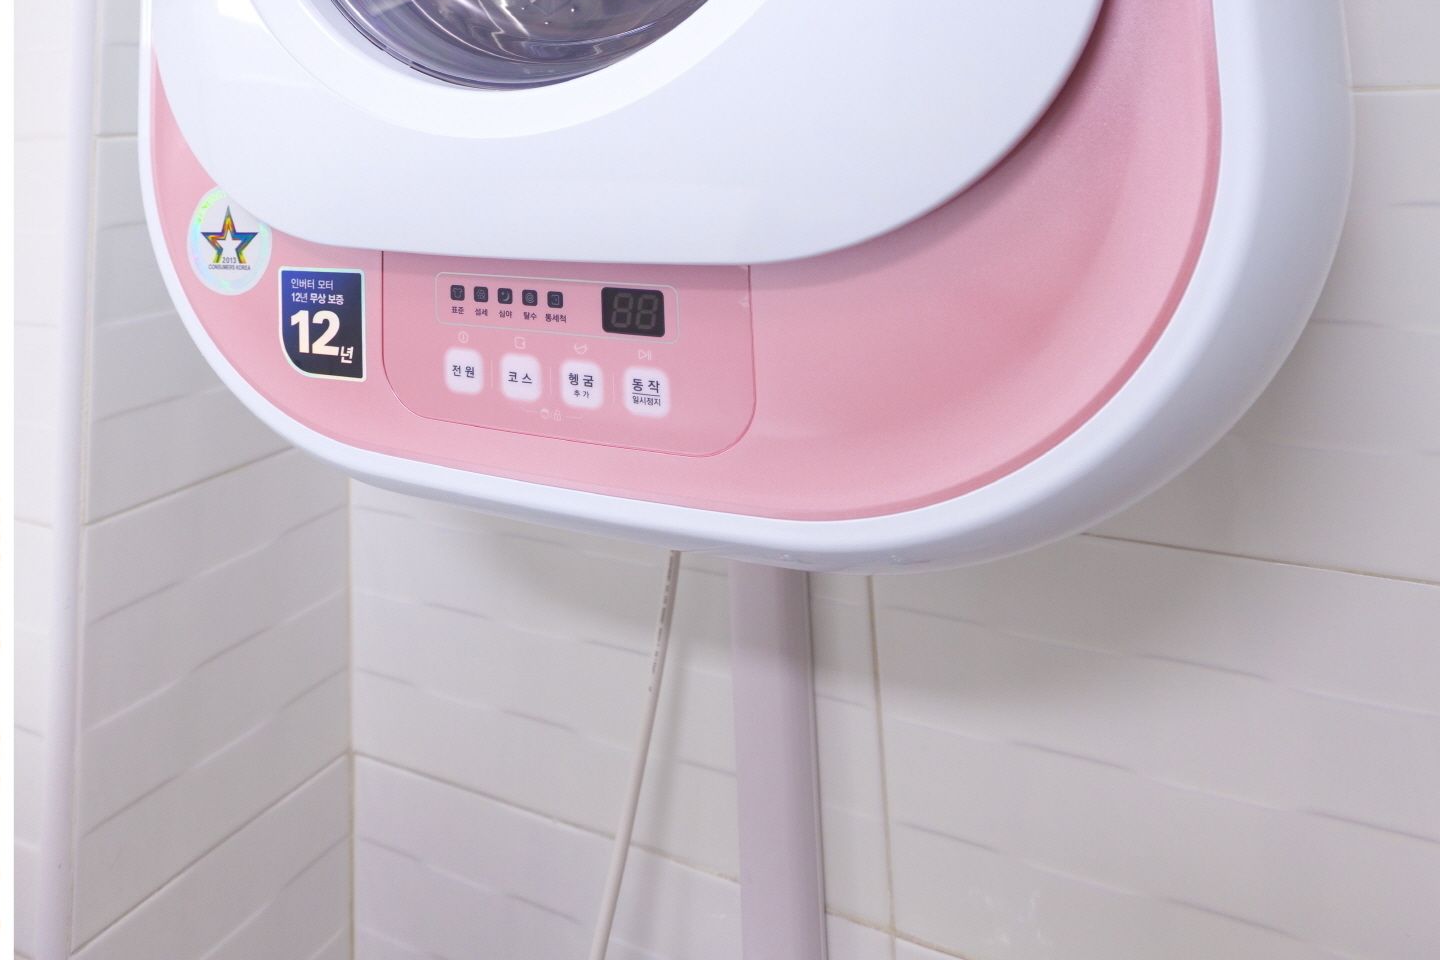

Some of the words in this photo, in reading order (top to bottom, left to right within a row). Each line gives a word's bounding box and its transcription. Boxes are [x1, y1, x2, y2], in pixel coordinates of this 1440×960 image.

[222, 256, 237, 264] 2013
[291, 278, 315, 290] 인버터
[317, 280, 334, 291] 모터
[291, 292, 308, 303] 12년
[310, 293, 326, 304] 무상
[327, 294, 345, 306] 보증
[451, 306, 465, 315] 표준
[523, 311, 537, 320] 탈수
[545, 313, 567, 323] 통세척
[632, 395, 661, 406] 일시정지
